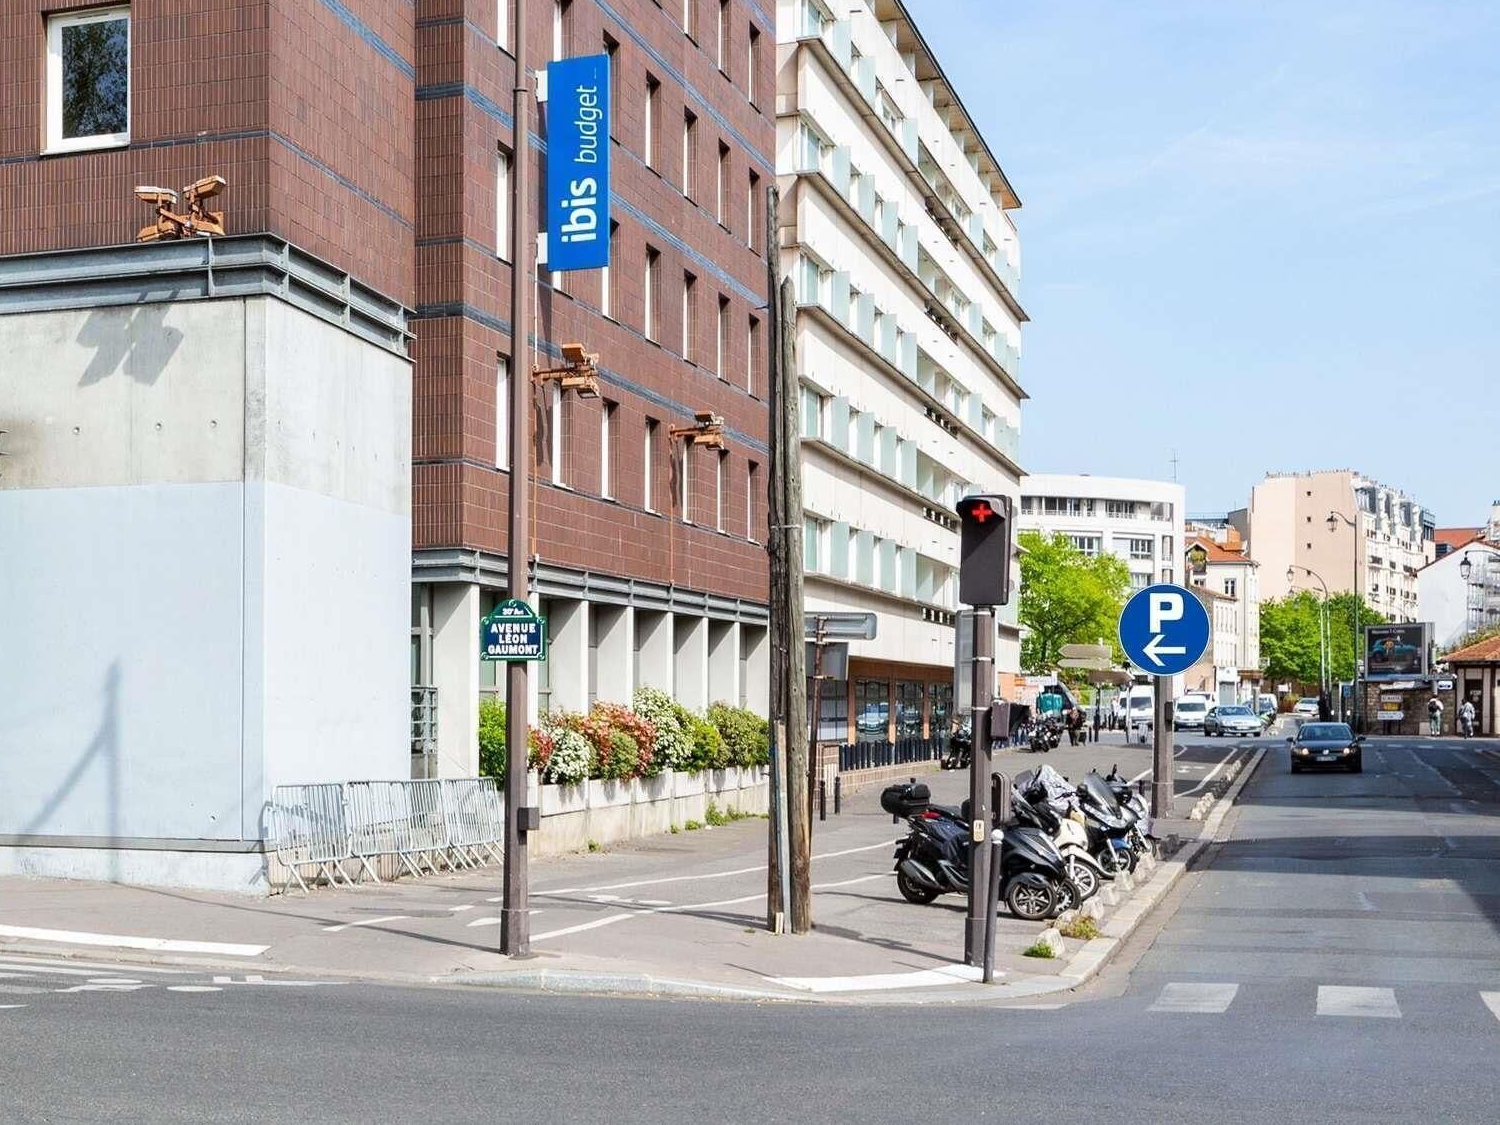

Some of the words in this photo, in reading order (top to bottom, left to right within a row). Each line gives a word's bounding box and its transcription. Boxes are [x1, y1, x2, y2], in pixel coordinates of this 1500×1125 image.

[573, 85, 603, 163] budget
[561, 177, 597, 242] ibis
[1149, 592, 1184, 633] P
[491, 623, 536, 633] AVENUE
[499, 633, 527, 644] LÉON
[488, 645, 538, 655] GAUMONT
